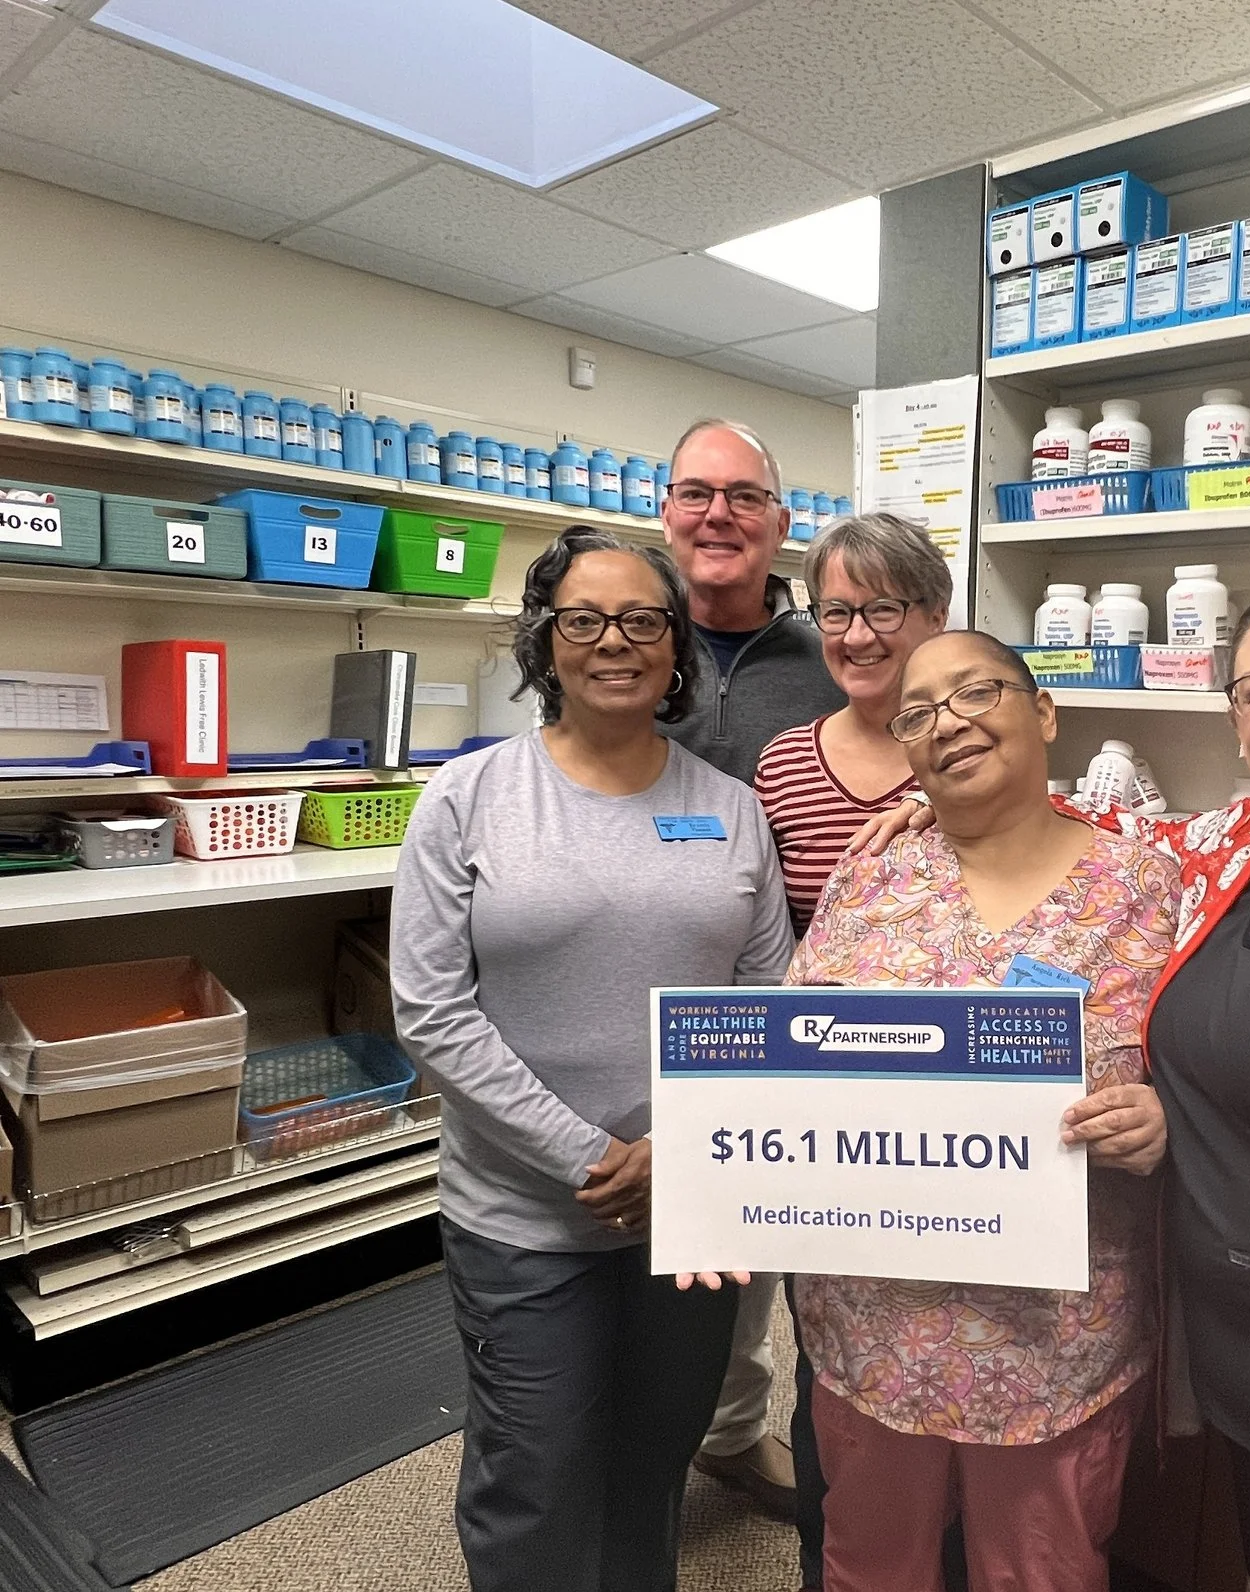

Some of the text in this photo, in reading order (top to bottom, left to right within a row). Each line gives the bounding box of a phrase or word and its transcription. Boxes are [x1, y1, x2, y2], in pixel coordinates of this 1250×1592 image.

[172, 535, 197, 551] 20
[311, 536, 328, 552] 13
[445, 549, 456, 562] 8
[199, 713, 207, 729] Free
[198, 731, 207, 753] Clinic
[669, 1006, 768, 1015] WORKING TOWARD
[980, 1007, 1066, 1016] MEDICATION
[669, 1017, 766, 1029] A HEALTHIER
[980, 1019, 1068, 1032] ACCESS TO
[690, 1033, 766, 1045] EQUITABLE
[833, 1032, 932, 1044] PARTNERSHIP
[967, 1006, 976, 1064] INCREASING
[979, 1035, 1070, 1046] STRENGTHEN THE
[690, 1049, 766, 1059] VIRGINIA
[980, 1048, 1042, 1064] HEALTH
[1043, 1048, 1072, 1056] SAFETY
[711, 1127, 1030, 1170] $16.1 MILLION
[743, 1204, 1001, 1236] Medication Dispensed
